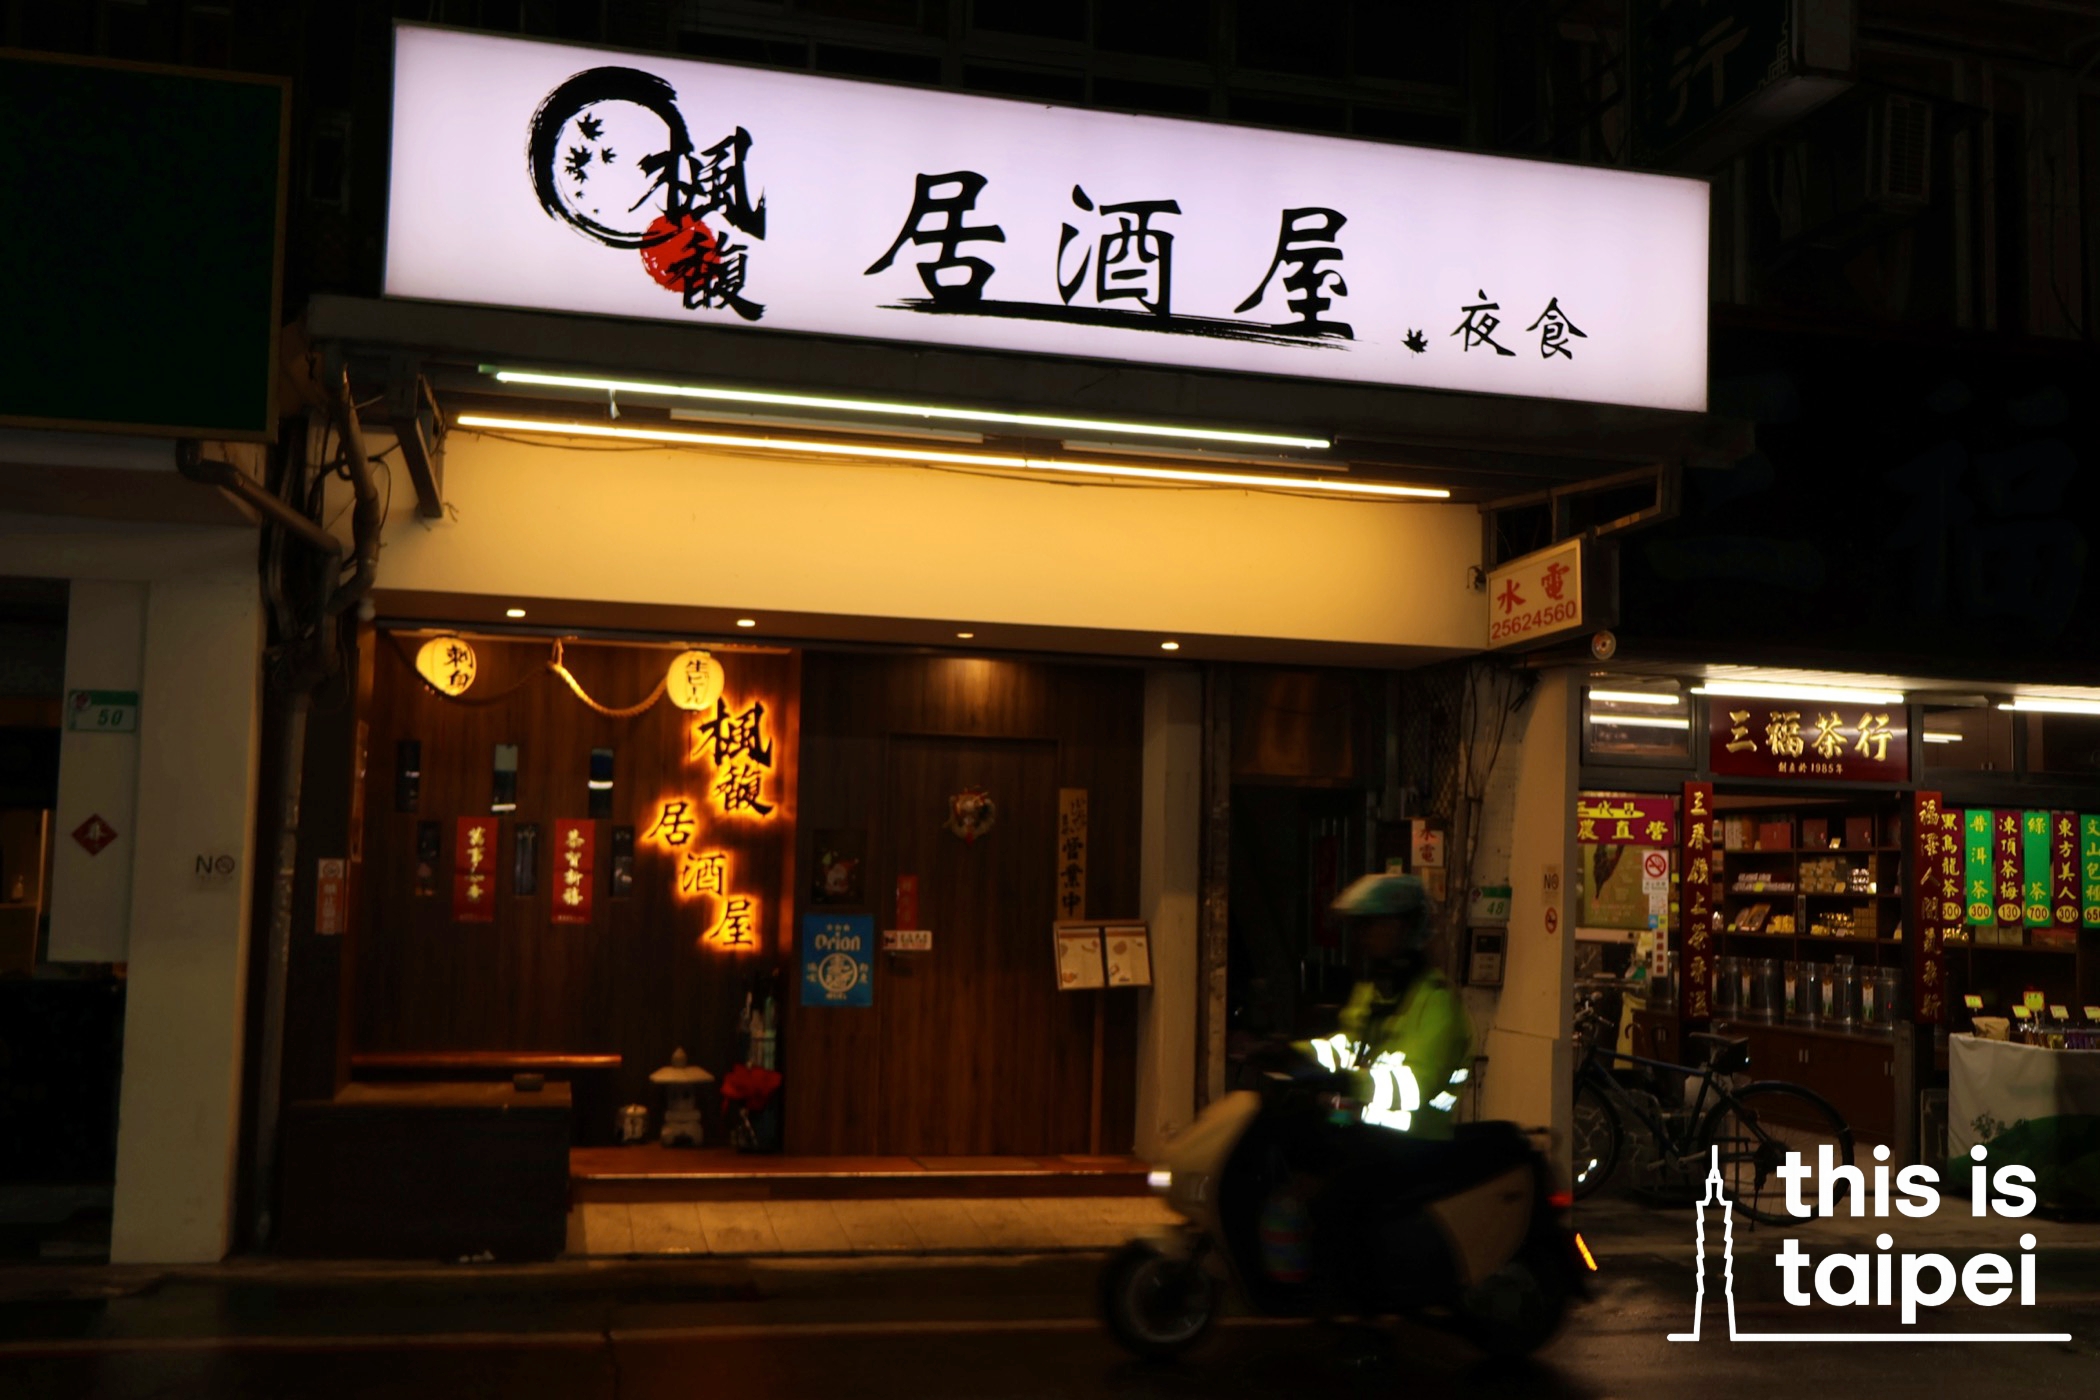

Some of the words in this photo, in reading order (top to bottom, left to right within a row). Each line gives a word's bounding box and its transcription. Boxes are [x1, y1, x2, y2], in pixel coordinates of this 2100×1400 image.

[863, 170, 1355, 341] 居酒屋
[1452, 289, 1589, 360] 夜食
[1496, 562, 1570, 614] 水電
[1491, 600, 1577, 641] 25624560
[97, 709, 124, 726] 50
[1725, 709, 1894, 762] 三福茶行
[1419, 826, 1437, 863] 水電
[1577, 818, 1669, 841] 農直營
[645, 801, 755, 947] 居酒屋
[1969, 814, 1989, 900] 普洱茶
[2027, 817, 2047, 902] 綠茶
[2057, 817, 2077, 901] 東方美人
[1486, 901, 1505, 915] 48
[1971, 905, 1990, 918] 300
[2002, 905, 2018, 919] 130
[2029, 906, 2048, 920] 700
[2059, 908, 2077, 921] 300
[815, 932, 861, 951] Orion
